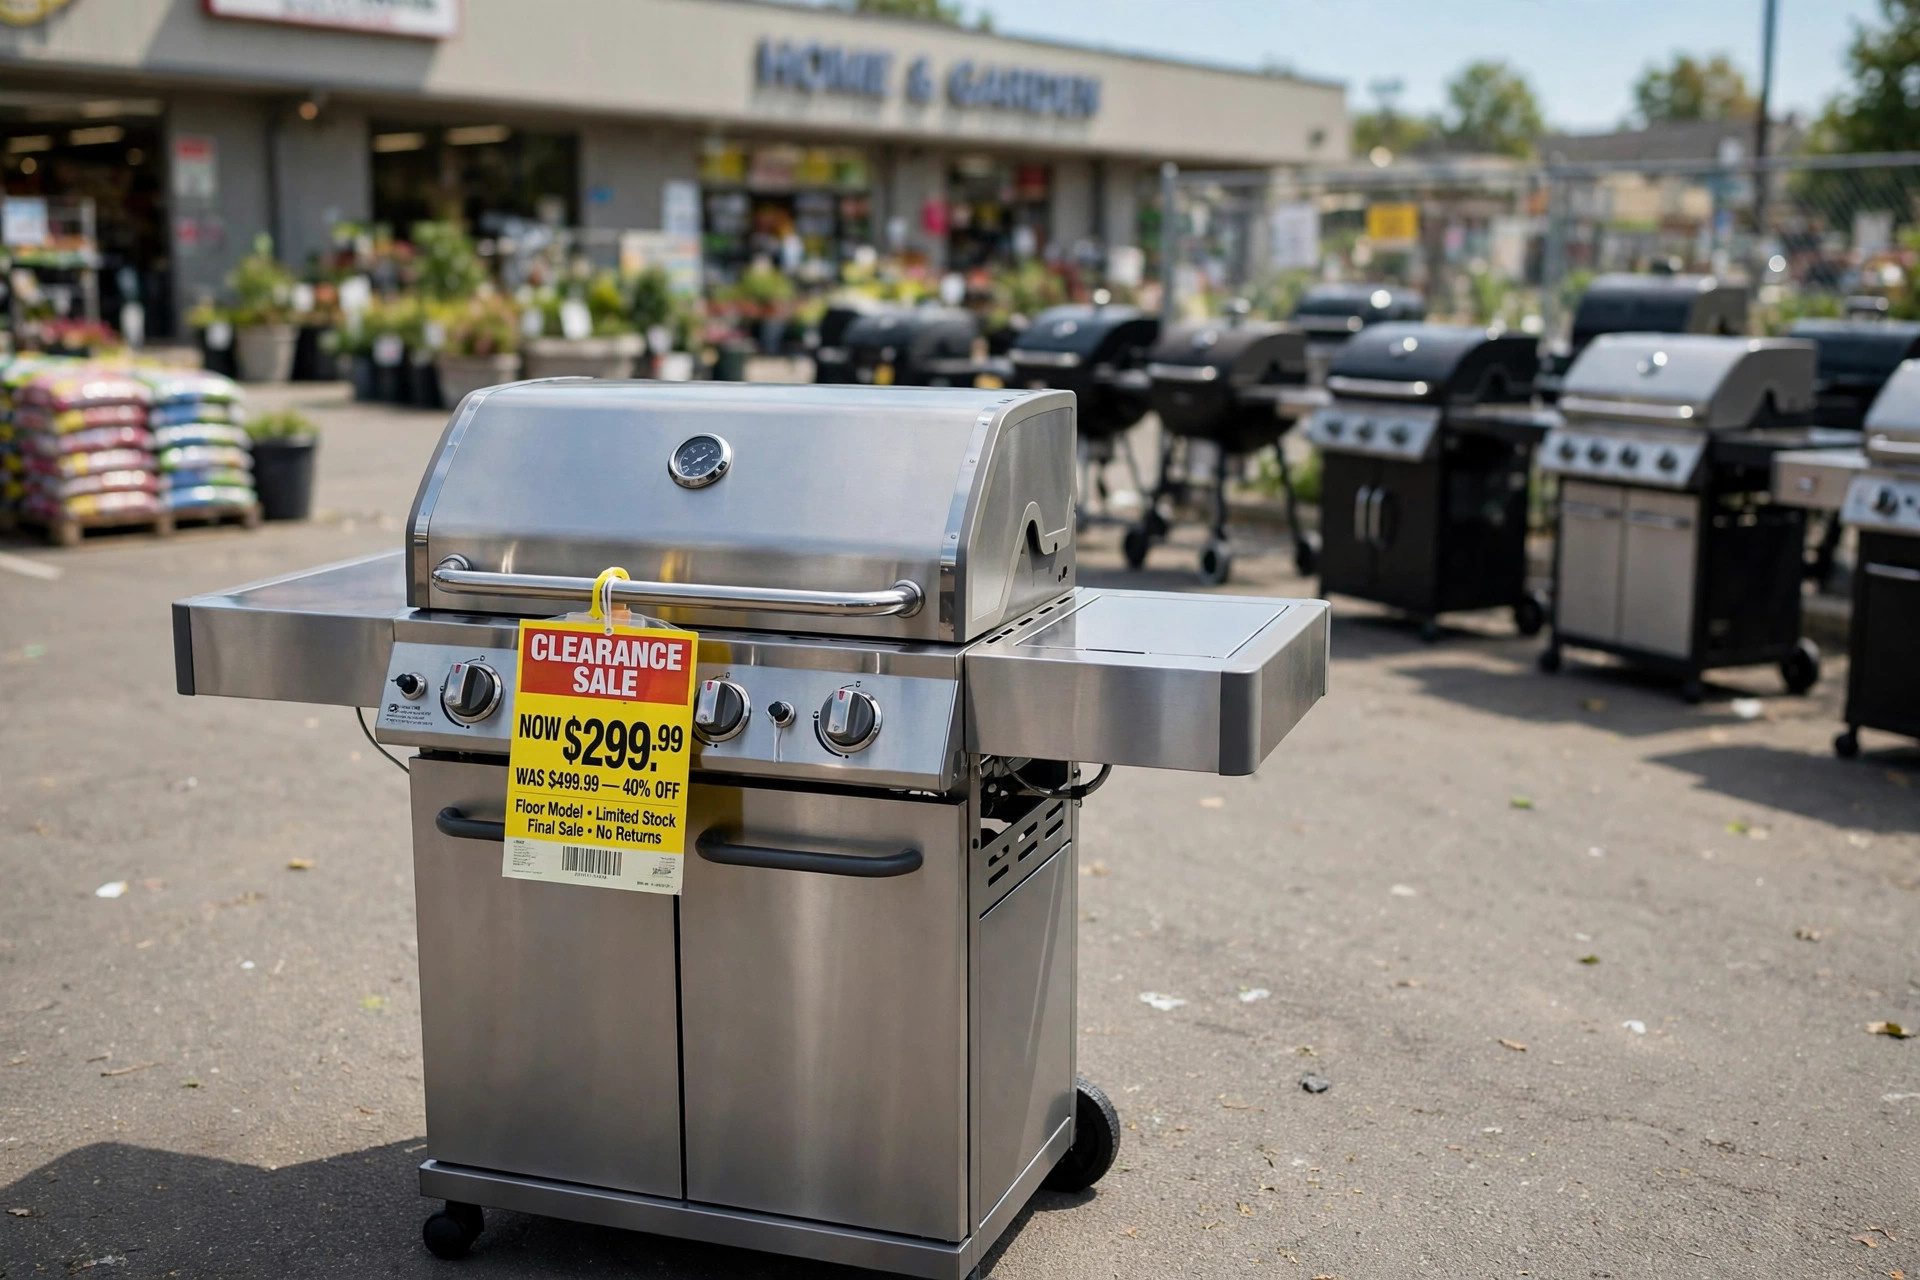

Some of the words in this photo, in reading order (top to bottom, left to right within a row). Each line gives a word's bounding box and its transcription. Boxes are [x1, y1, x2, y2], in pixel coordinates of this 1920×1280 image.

[755, 39, 889, 98] HOME
[904, 56, 935, 104] &
[947, 59, 1104, 118] GARDEN
[531, 633, 682, 671] CLEARANCE
[573, 666, 637, 697] SALE
[519, 713, 562, 742] NOW
[516, 767, 545, 787] WAS
[548, 770, 599, 792] $499.99
[622, 778, 650, 798] 40%
[655, 780, 681, 800] OFF
[515, 798, 545, 815] Floor
[548, 801, 583, 819] Model
[596, 806, 639, 825] Limited
[642, 810, 676, 828] Stock
[528, 818, 555, 835] Final
[558, 821, 584, 837] Sale
[596, 824, 612, 840] No
[616, 826, 662, 845] Returns
